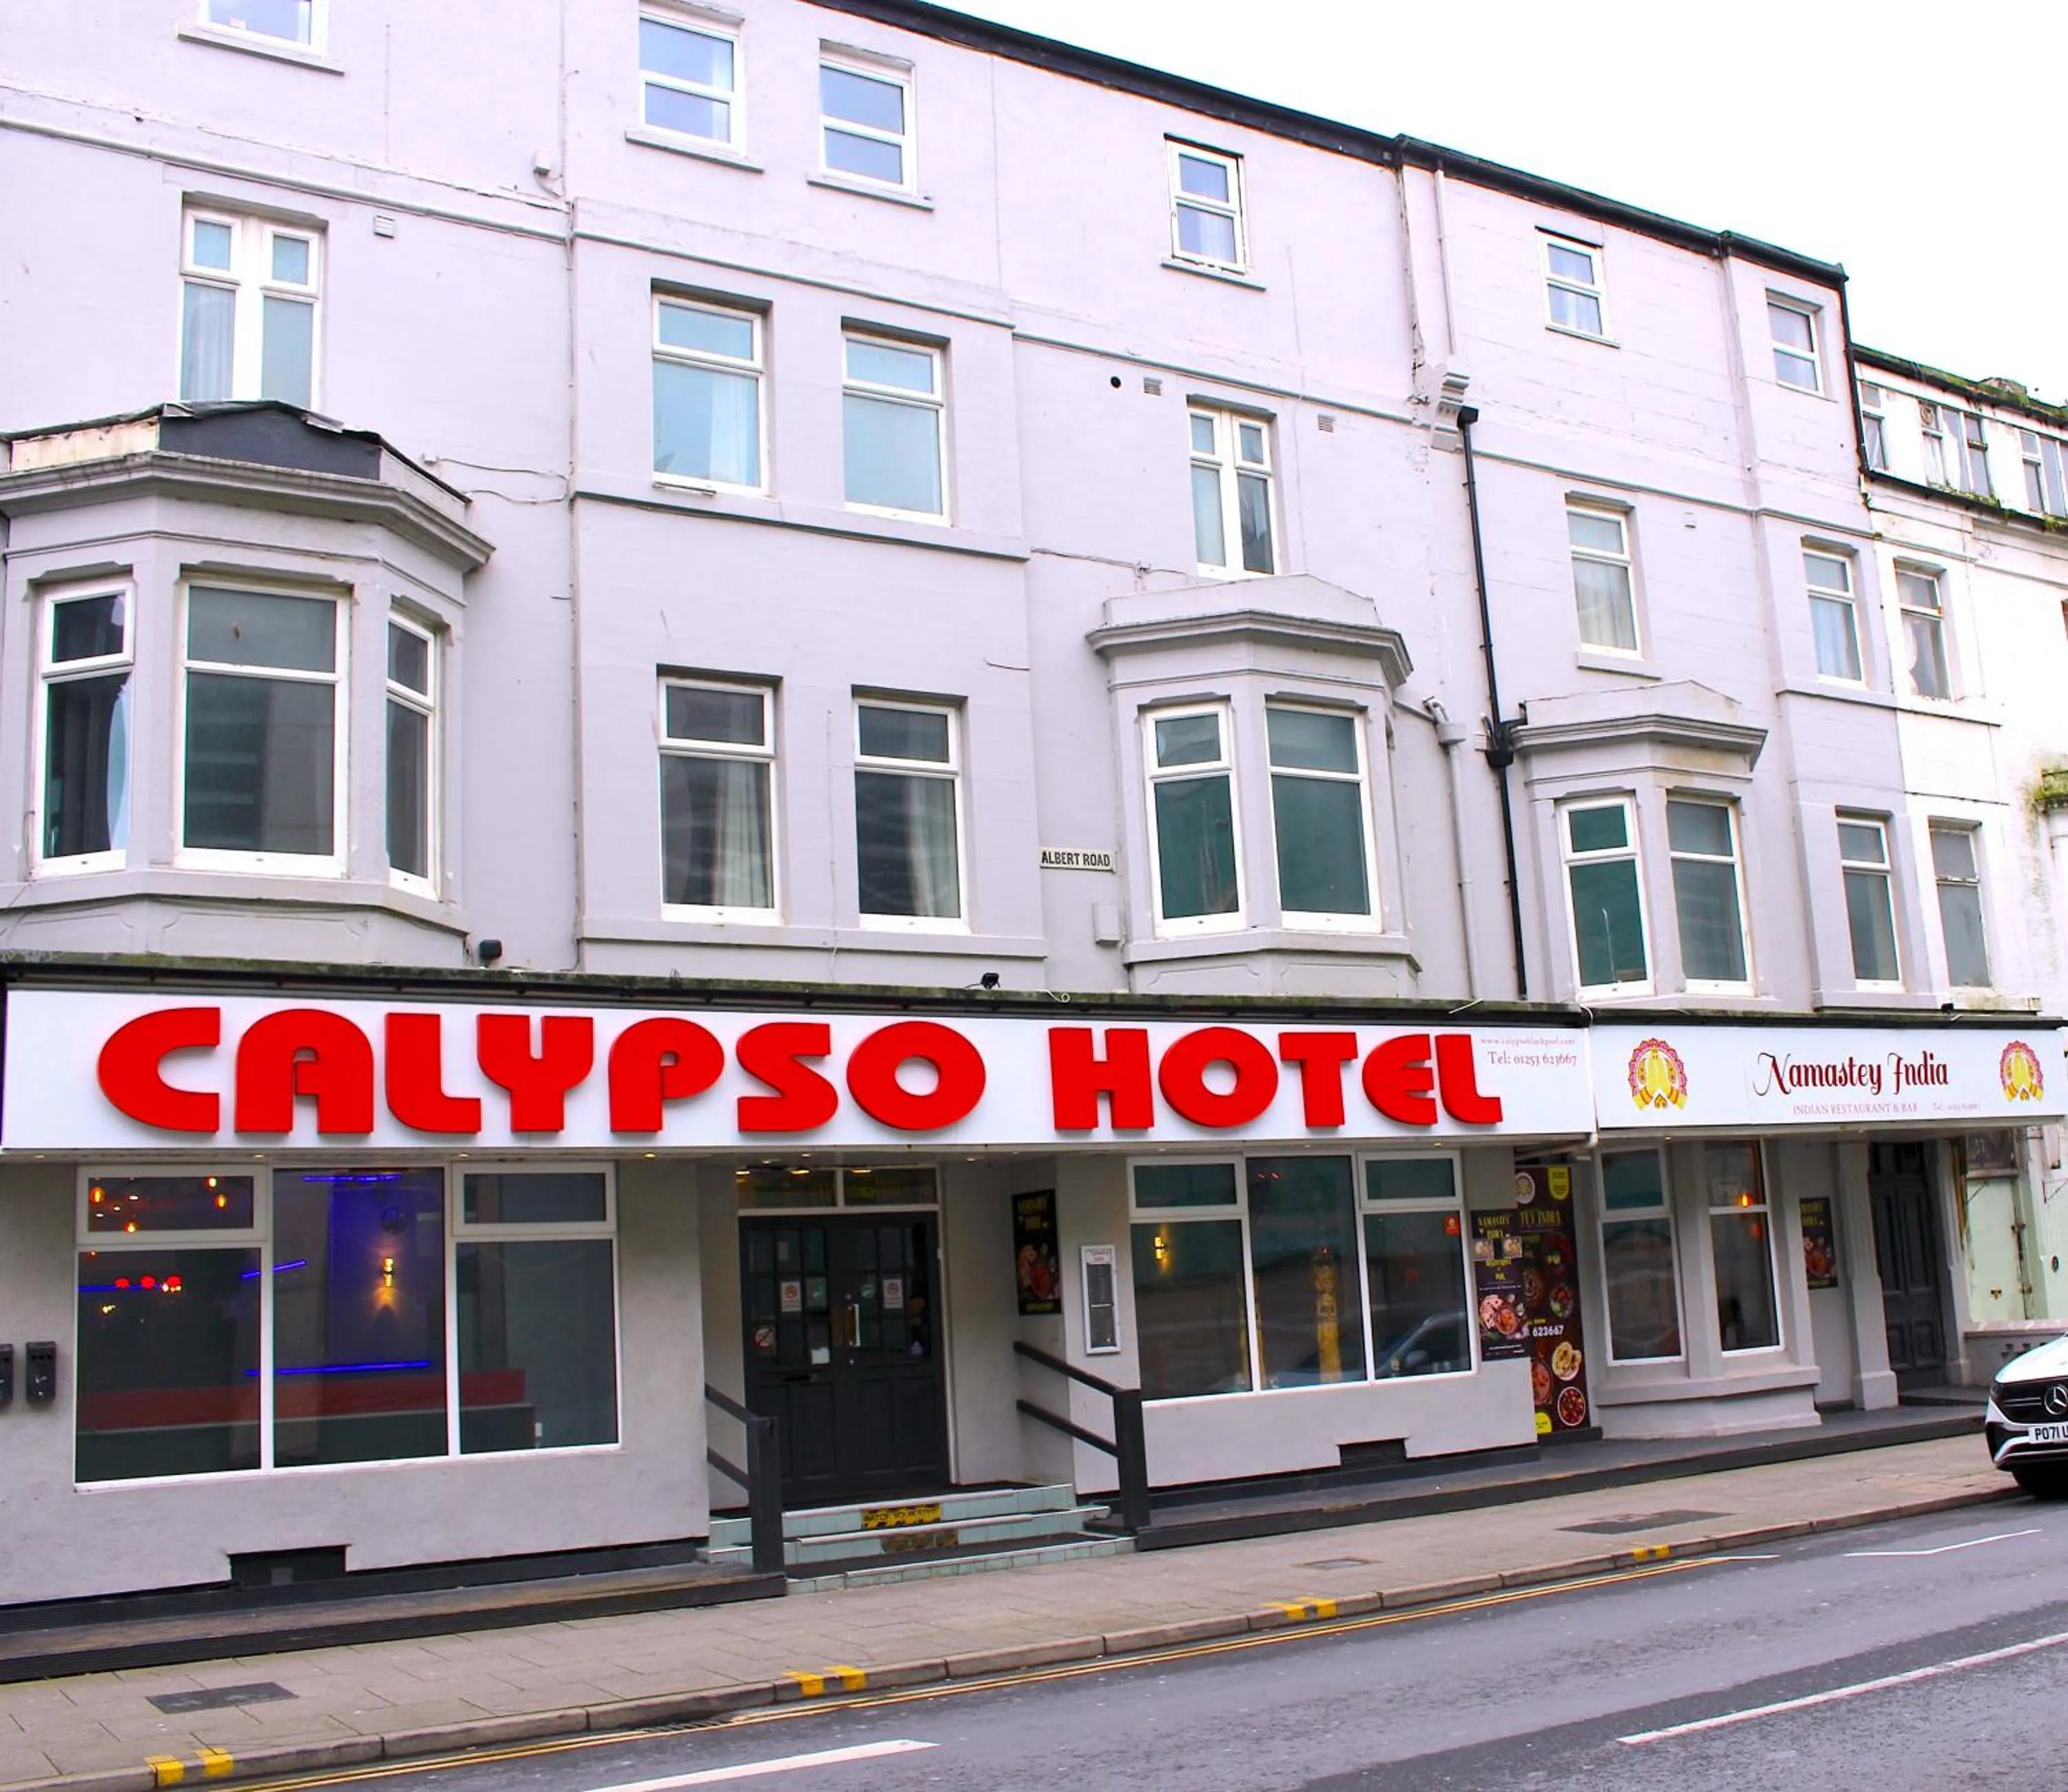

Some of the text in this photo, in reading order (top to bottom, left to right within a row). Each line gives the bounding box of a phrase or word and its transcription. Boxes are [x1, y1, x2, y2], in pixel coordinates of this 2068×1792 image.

[1042, 851, 1111, 866] ALBERT ROAD
[1488, 1051, 1577, 1067] Tel: 01253 623667
[97, 1007, 1503, 1134] CALYPSO HOTEL
[1753, 1050, 1949, 1097] Namastey India
[1793, 1103, 1828, 1115] INDIAN
[1831, 1103, 1889, 1114] RESTAURANT
[1532, 1324, 1564, 1337] 623667
